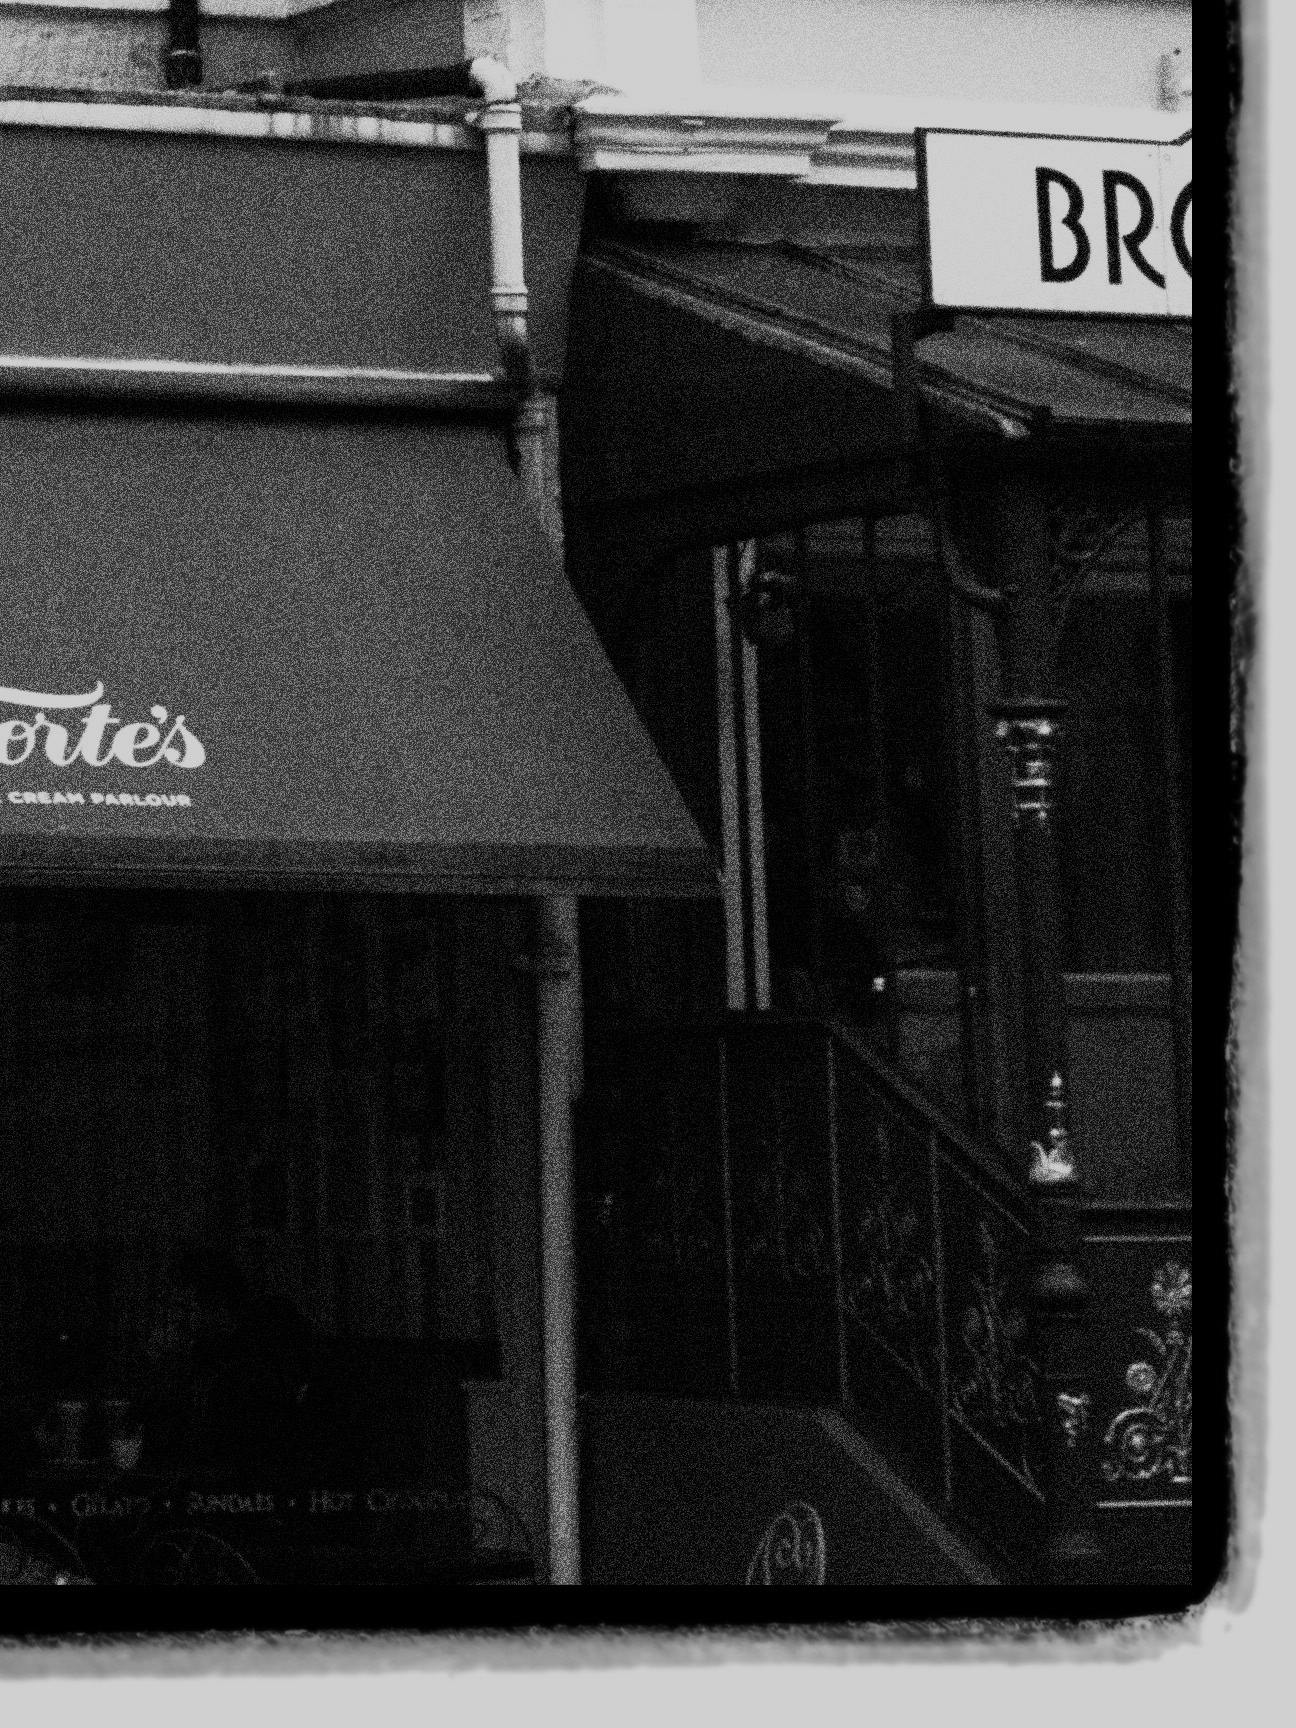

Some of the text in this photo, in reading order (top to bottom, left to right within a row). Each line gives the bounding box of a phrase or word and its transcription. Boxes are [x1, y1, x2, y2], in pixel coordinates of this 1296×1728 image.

[1035, 166, 1193, 290] BR
[7, 790, 86, 806] CREAM
[90, 791, 193, 809] PARLOUR
